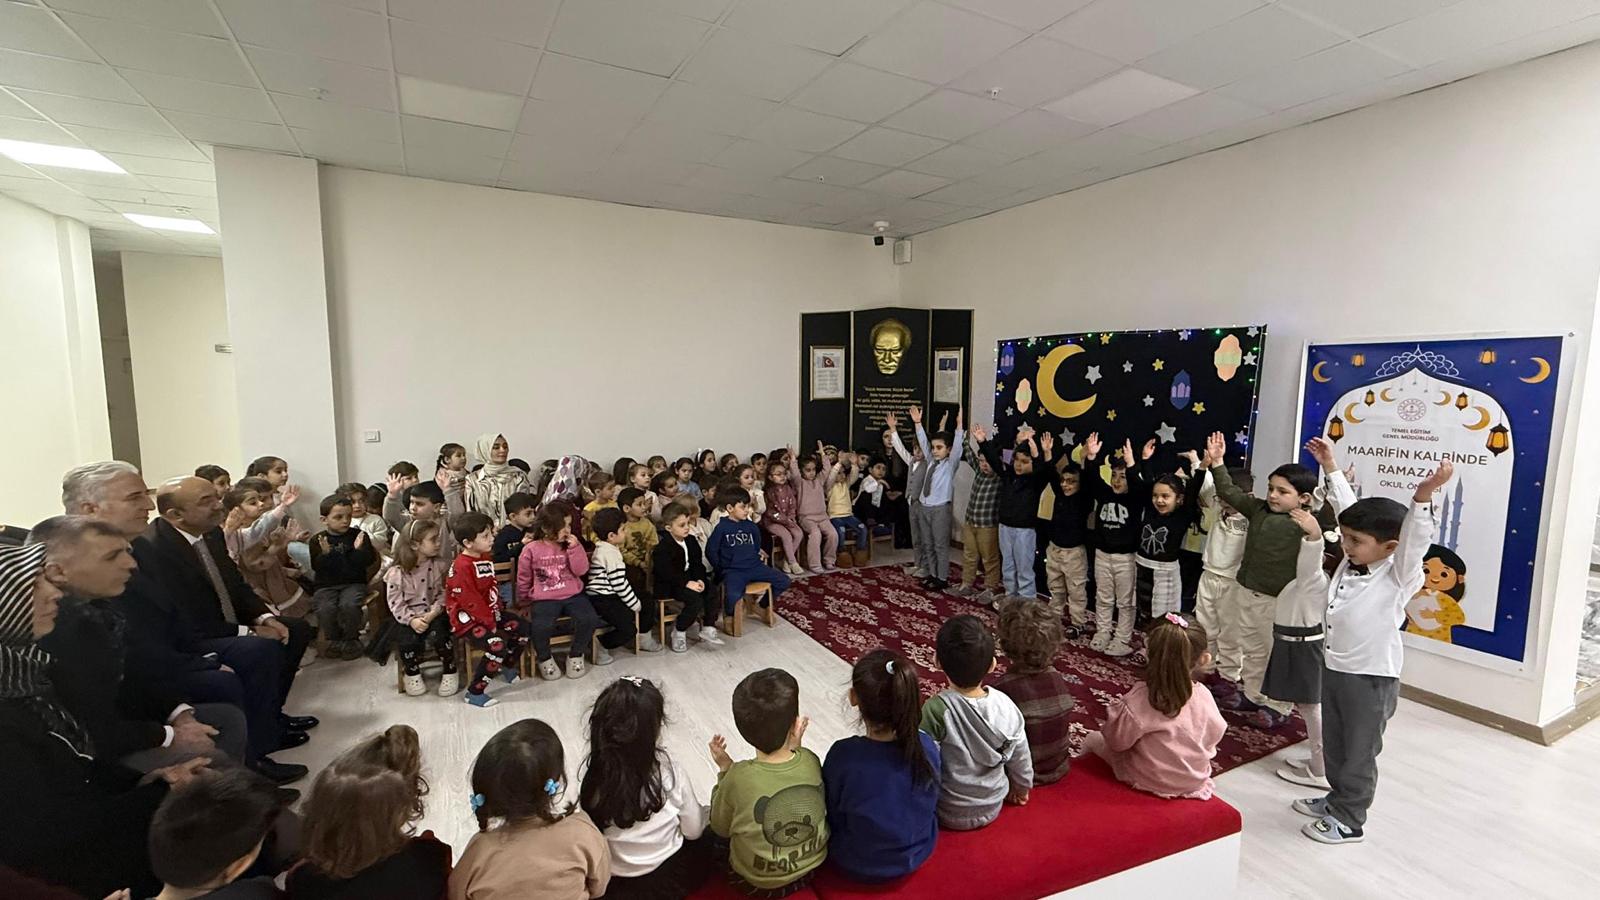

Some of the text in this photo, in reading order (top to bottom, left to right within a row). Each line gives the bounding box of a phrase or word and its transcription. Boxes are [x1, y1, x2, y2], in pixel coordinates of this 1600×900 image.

[1347, 445, 1488, 466] MAARİFİN KALBİNDE
[1377, 464, 1435, 478] RAMAZA
[1379, 480, 1404, 489] OKUL
[1100, 502, 1129, 524] GAP
